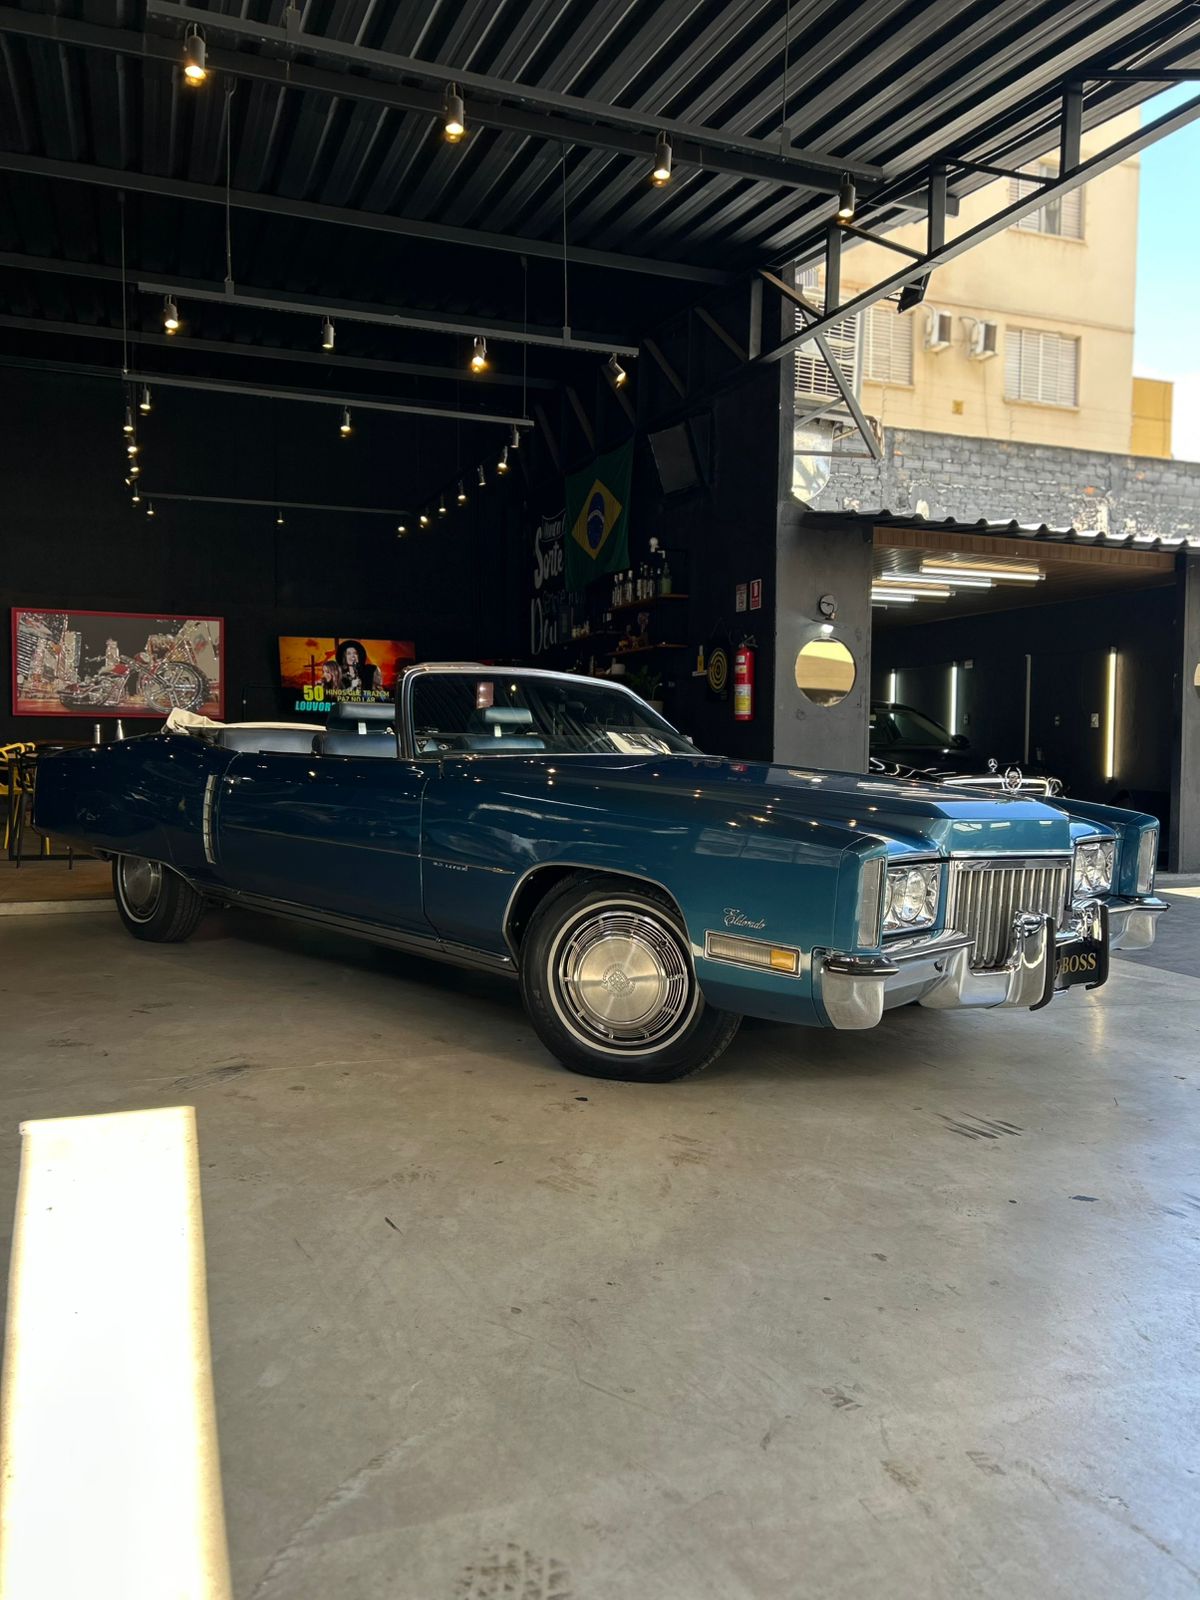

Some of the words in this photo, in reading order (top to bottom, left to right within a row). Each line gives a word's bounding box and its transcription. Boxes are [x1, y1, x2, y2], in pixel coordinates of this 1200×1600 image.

[530, 597, 559, 656] Deu
[303, 685, 325, 702] 50
[295, 700, 336, 712] LOUVOR
[723, 907, 766, 930] Eldorado
